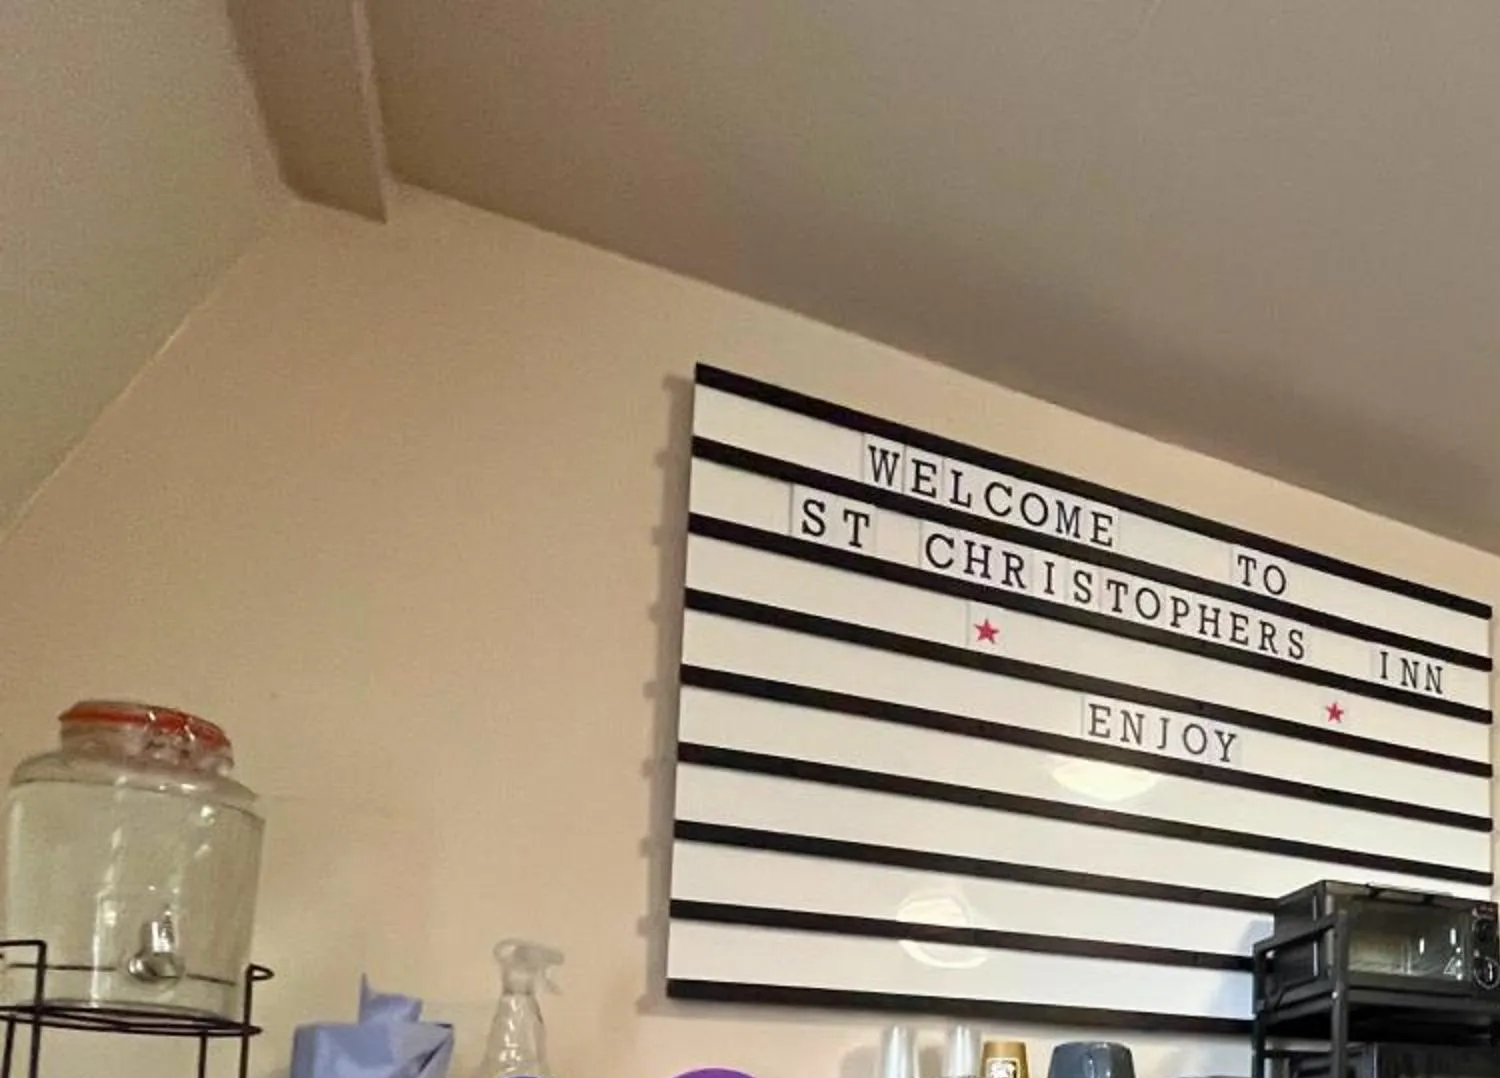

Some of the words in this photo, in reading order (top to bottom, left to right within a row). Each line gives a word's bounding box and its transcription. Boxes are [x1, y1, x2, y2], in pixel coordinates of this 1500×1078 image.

[868, 445, 1114, 548] WELCOME
[1237, 555, 1287, 596] TO
[802, 498, 870, 548] ST
[925, 533, 1306, 660] CHRISTOPHERS
[1380, 651, 1444, 695] INN
[1088, 703, 1238, 763] ENJOY
